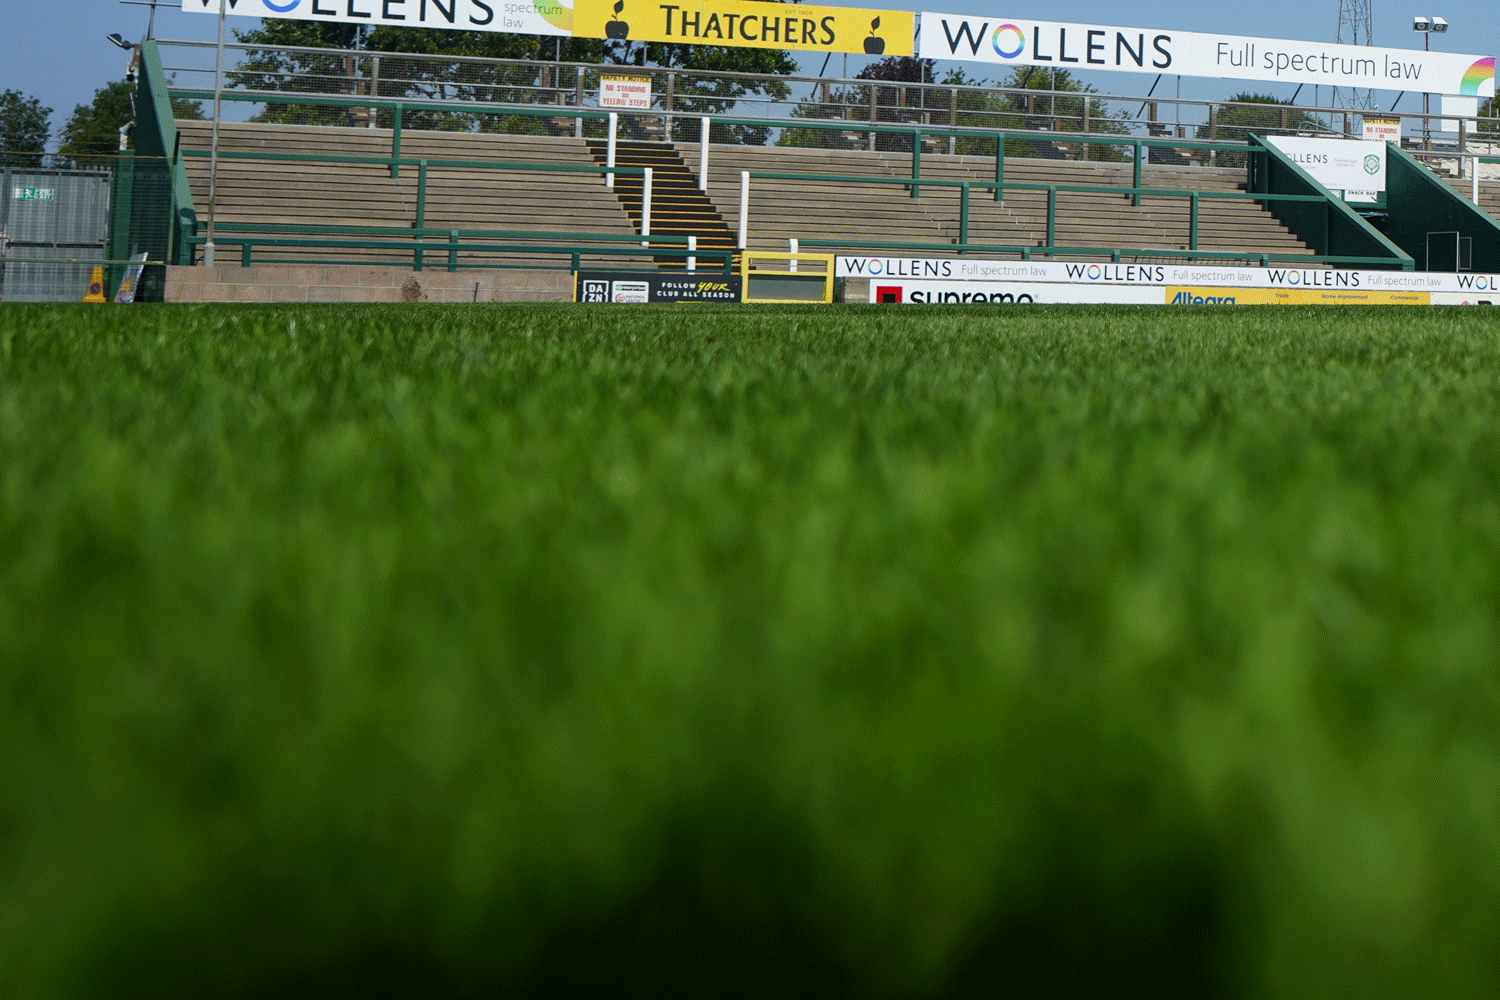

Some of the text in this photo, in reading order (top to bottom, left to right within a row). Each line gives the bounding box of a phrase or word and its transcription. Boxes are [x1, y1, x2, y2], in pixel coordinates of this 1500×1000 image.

[504, 3, 563, 15] spectrum
[503, 16, 524, 28] law
[659, 4, 836, 46] THATCHERS
[941, 19, 1423, 80] WOLLENS Full spectrum law
[616, 85, 647, 93] STANDING
[602, 98, 627, 106] YELLOW
[845, 258, 1048, 277] WOLLENS Full spectrum law
[1065, 264, 1254, 282] WOLLENS Full spectrum law
[1267, 269, 1442, 287] WOLLENS Full spectrum law
[697, 281, 731, 293] YOUR
[702, 291, 735, 299] SEASON
